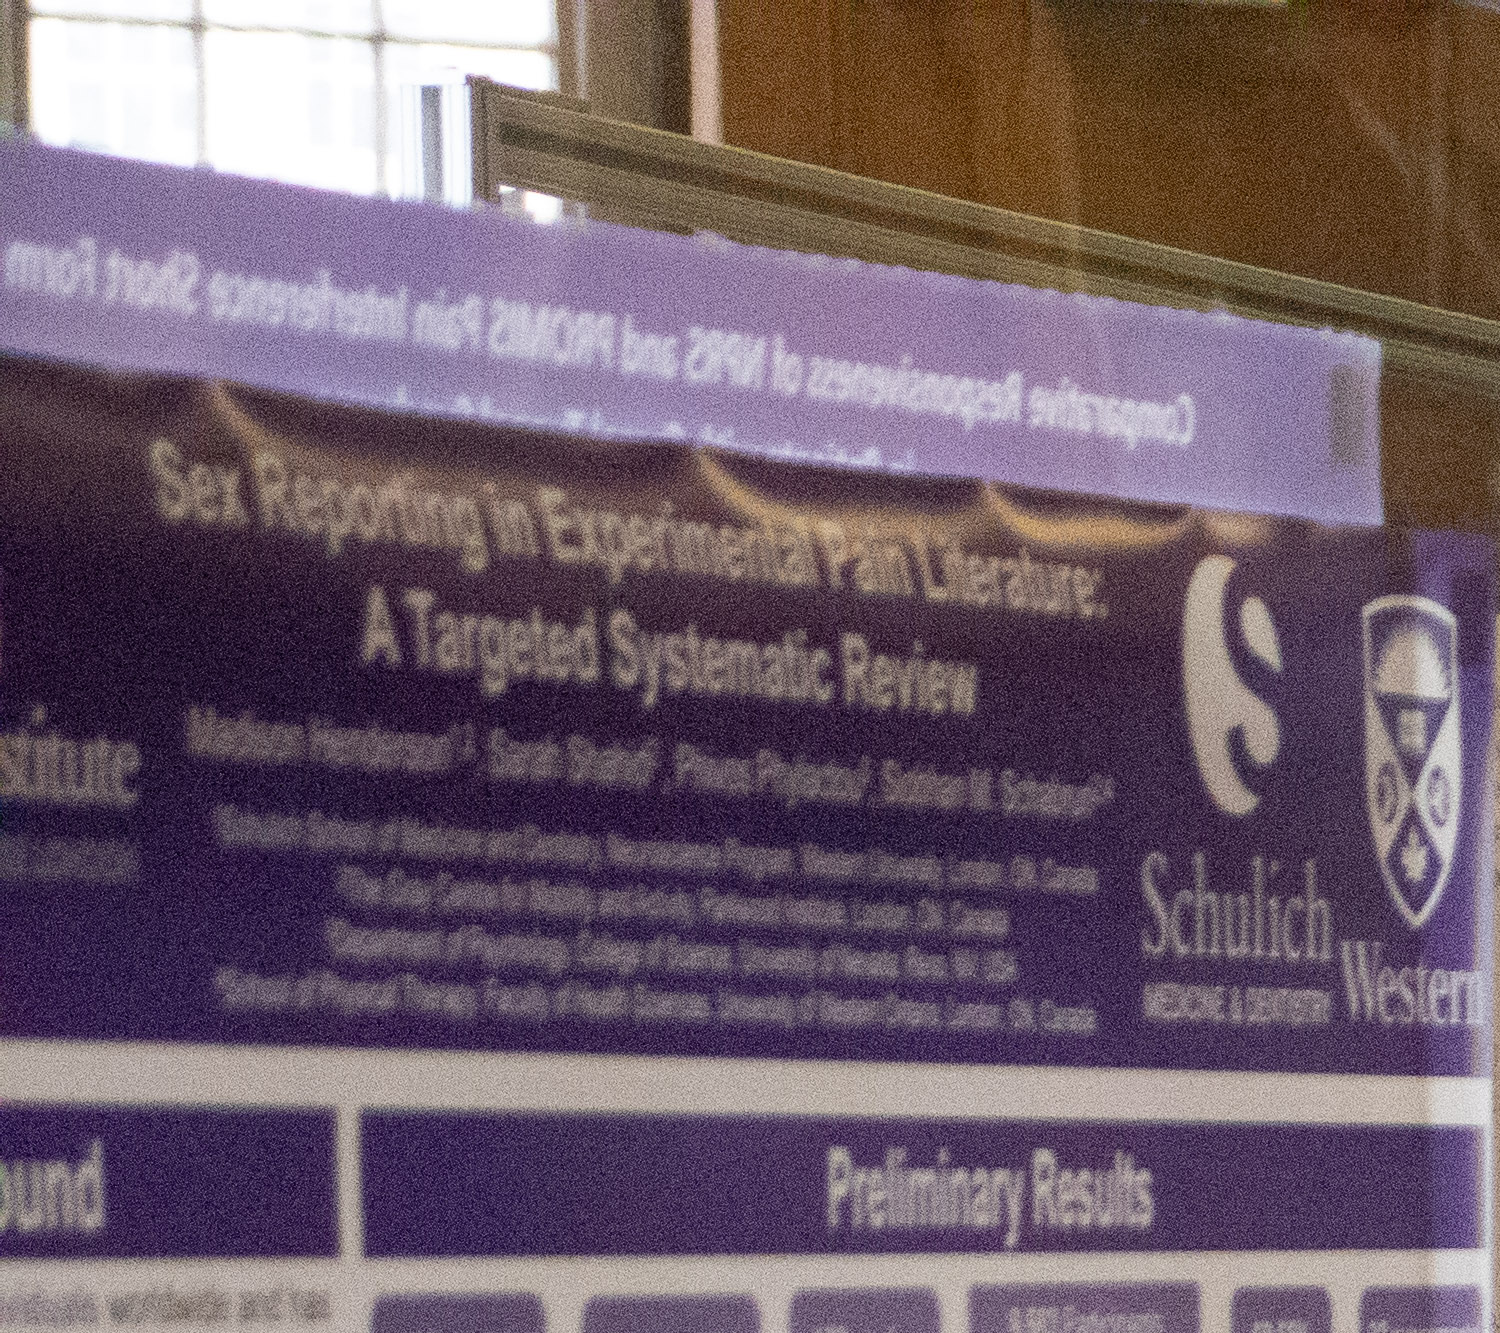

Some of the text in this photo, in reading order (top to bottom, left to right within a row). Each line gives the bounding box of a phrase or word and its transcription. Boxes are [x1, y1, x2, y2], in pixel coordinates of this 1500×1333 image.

[150, 437, 251, 526] Sex
[255, 455, 485, 573] Reporting
[487, 483, 538, 557] in
[540, 487, 819, 587] Experimental
[824, 518, 914, 596] Pain
[361, 585, 977, 716] A Targeted Systematic Review
[1140, 852, 1335, 963] Schulich
[1340, 938, 1486, 1027] Western
[826, 1146, 1155, 1249] Preliminary Results
